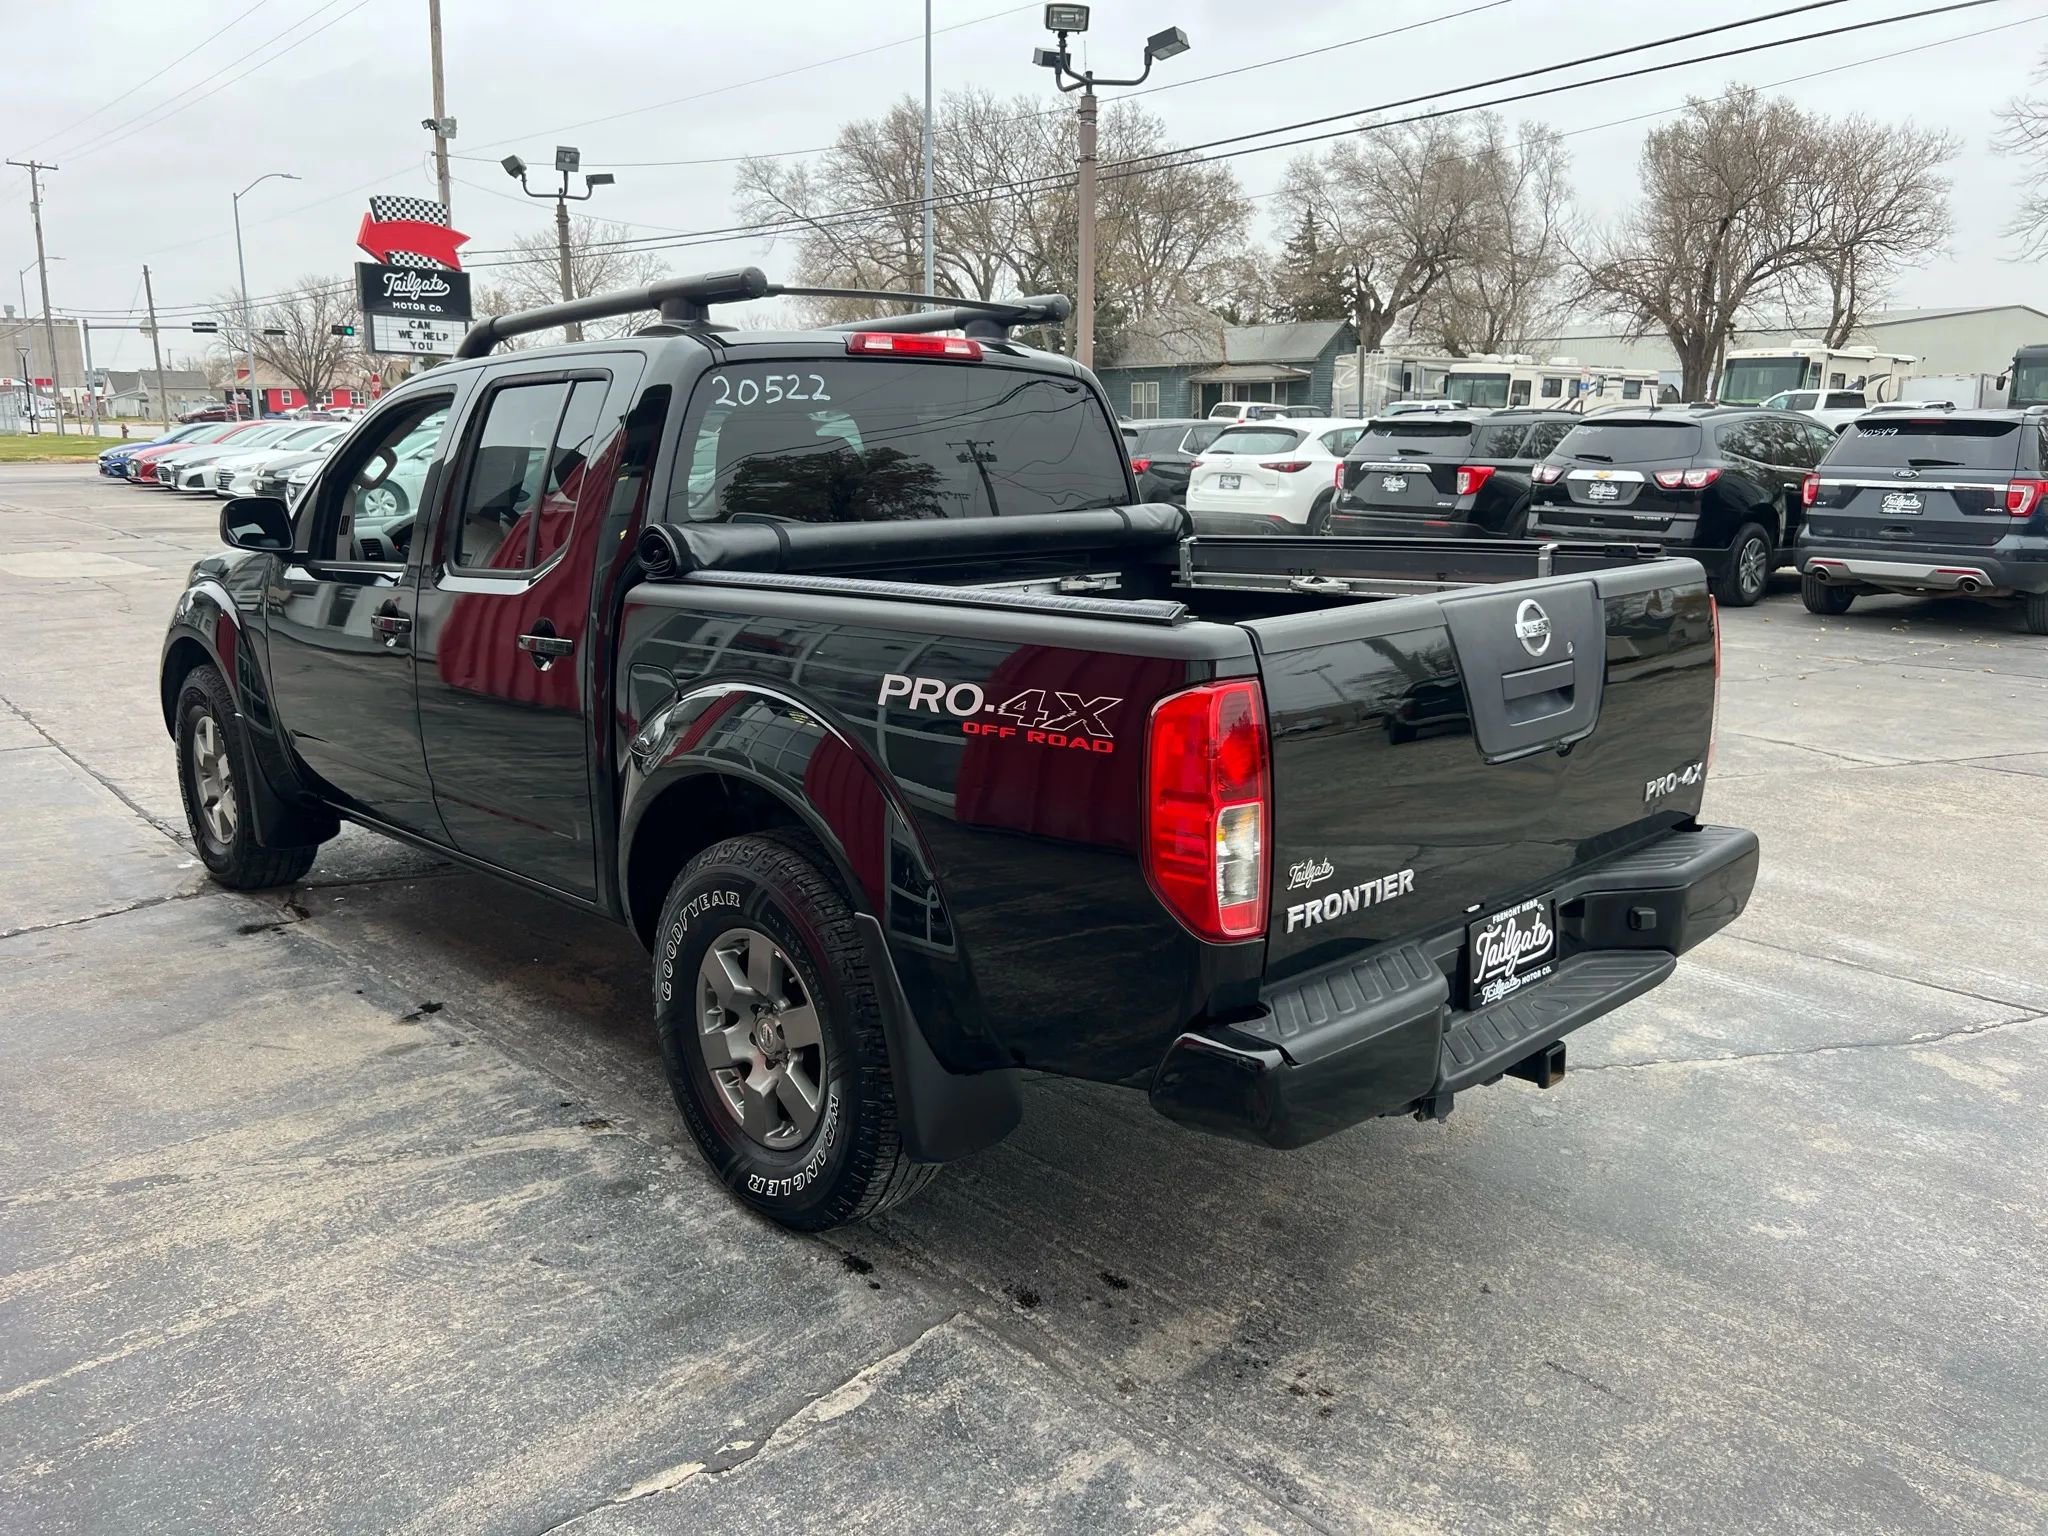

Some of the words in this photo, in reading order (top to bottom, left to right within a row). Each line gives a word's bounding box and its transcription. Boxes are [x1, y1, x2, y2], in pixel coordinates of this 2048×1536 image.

[383, 271, 450, 300] Tailgate
[393, 302, 426, 311] MOTOR
[398, 330, 413, 339] WE
[423, 332, 449, 341] HELP
[409, 320, 431, 330] CAN
[410, 341, 433, 351] YOU
[712, 374, 831, 406] 20522
[1857, 428, 1899, 438] 20549
[1881, 494, 1922, 511] Tailgate
[962, 721, 1016, 738] OFF
[1027, 730, 1114, 753] ROAD
[1644, 762, 1704, 802] PRO-4X
[1286, 857, 1335, 891] Tailgate
[1286, 868, 1415, 934] FRONTIER
[1492, 906, 1521, 925] FREMONT
[661, 890, 741, 1001] GOODYEAR
[1473, 912, 1554, 984] Tailgate
[1481, 974, 1521, 1005] Tailgate
[1521, 973, 1542, 985] MOTOR
[748, 1093, 839, 1197] WRANGLER
